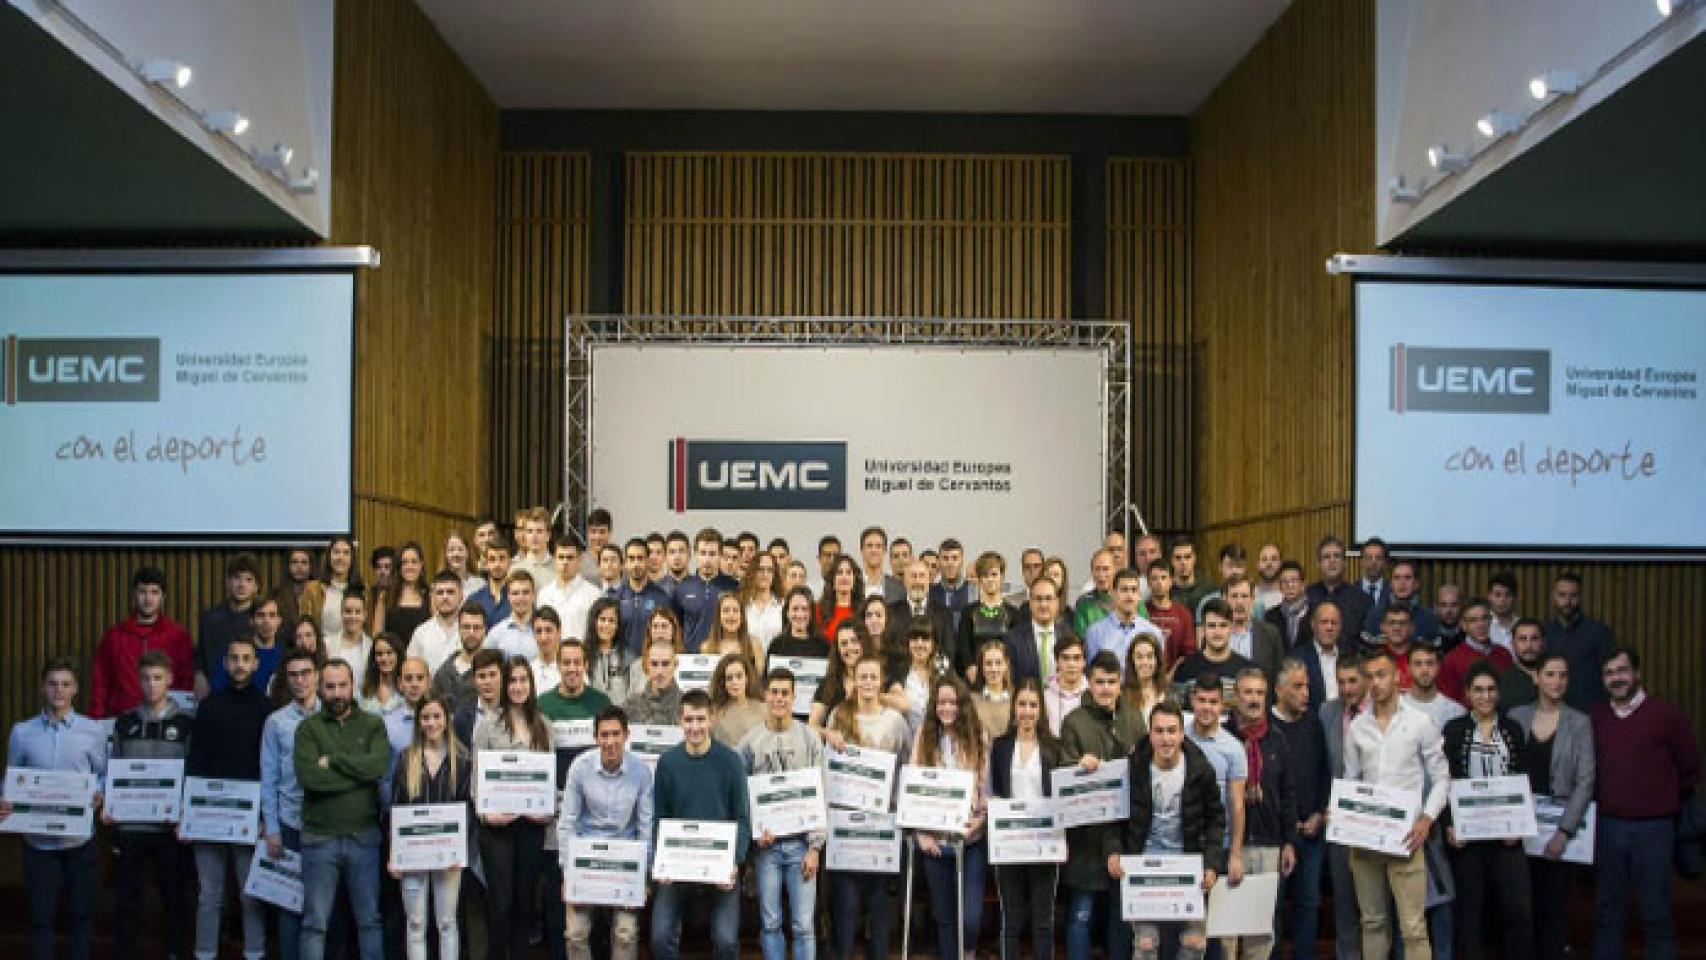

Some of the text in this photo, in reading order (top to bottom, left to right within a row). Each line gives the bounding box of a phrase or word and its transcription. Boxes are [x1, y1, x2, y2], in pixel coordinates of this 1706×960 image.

[28, 354, 146, 384] UEMC
[176, 352, 251, 367] Universidad
[176, 369, 218, 386] Miguel
[222, 369, 239, 383] de
[1417, 364, 1535, 395] UEMC
[1566, 366, 1640, 382] Universidad
[1566, 383, 1608, 400] Miguel
[1613, 384, 1628, 398] de
[56, 425, 268, 474] con el deporte
[864, 458, 1012, 478] Universidad Europea
[1445, 440, 1657, 488] con el deporte
[699, 460, 831, 490] UEMC
[864, 477, 1012, 495] Miguel de Cervantes
